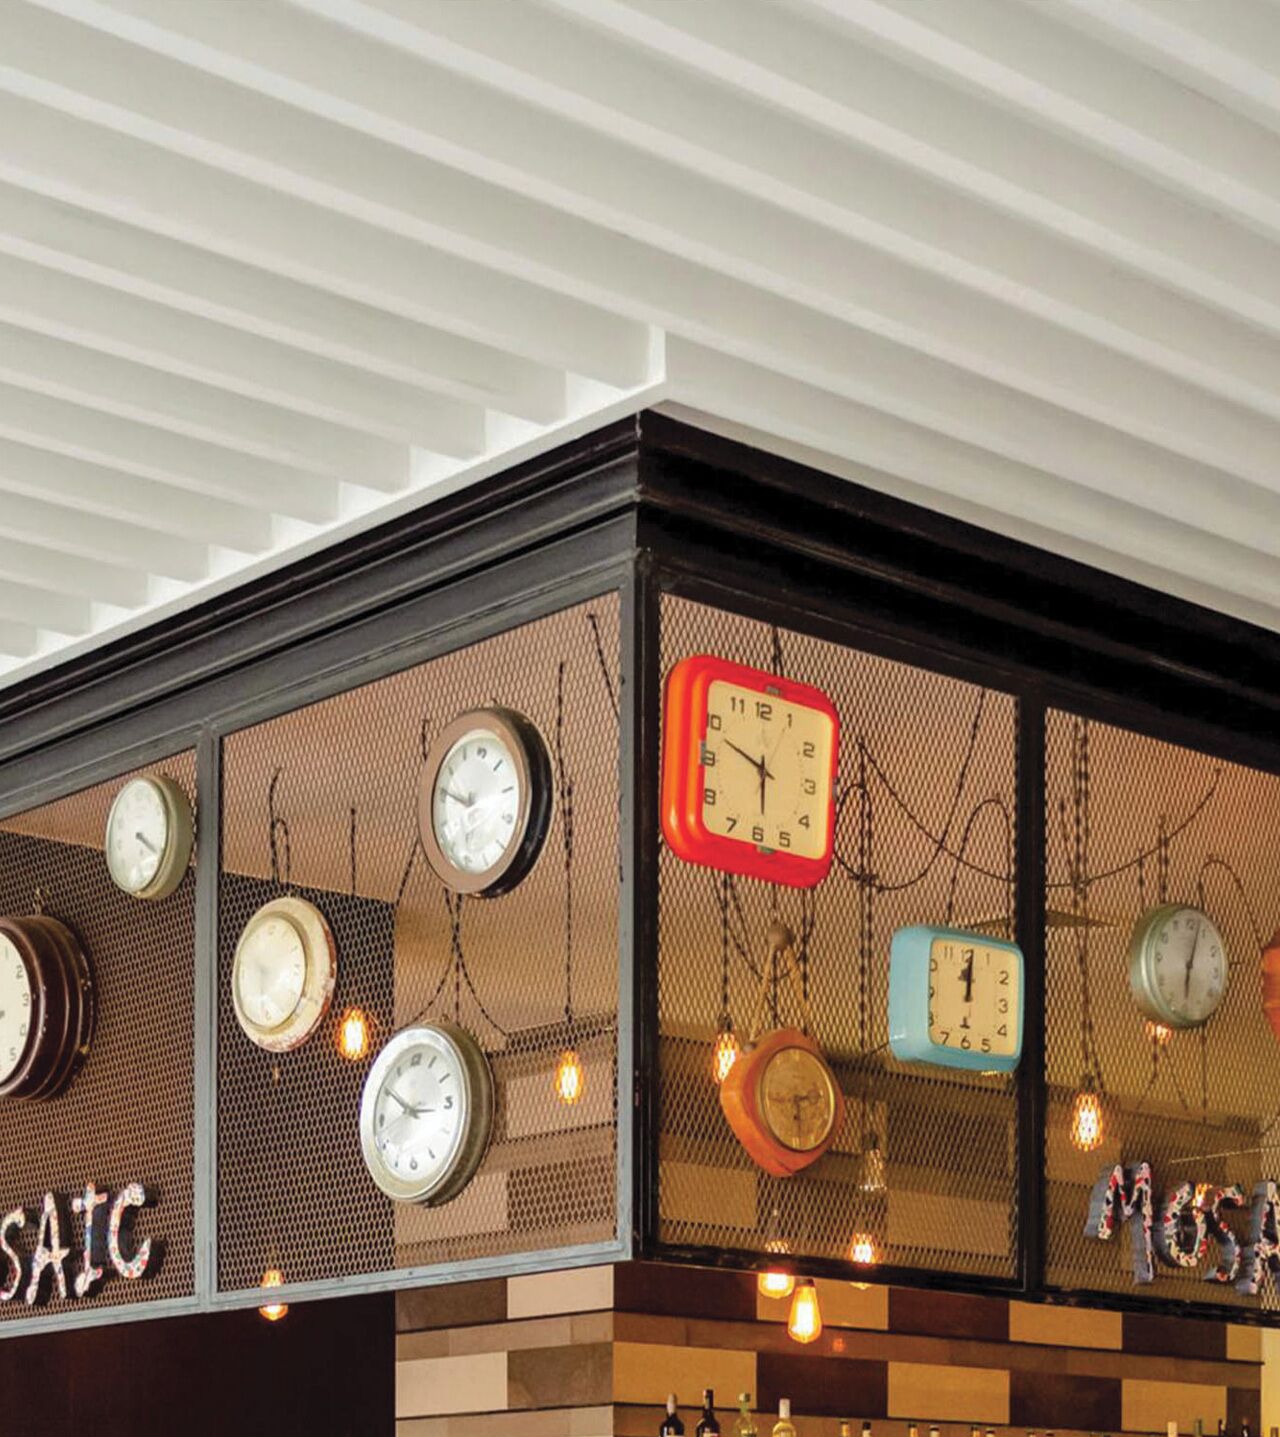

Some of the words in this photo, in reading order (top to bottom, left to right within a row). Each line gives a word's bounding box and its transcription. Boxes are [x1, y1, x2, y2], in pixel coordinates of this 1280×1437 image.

[731, 697, 745, 714] 11
[755, 701, 772, 721] 12
[787, 713, 792, 728] 1
[803, 741, 815, 758] 2
[804, 778, 816, 795] 3
[704, 788, 716, 805] 8
[725, 817, 737, 833] 7
[798, 815, 810, 830] 4
[752, 826, 764, 842] 6
[779, 832, 790, 848] 5
[944, 946, 953, 961] 11
[999, 970, 1009, 985] 2
[998, 999, 1008, 1014] 3
[997, 1024, 1008, 1037] 4
[940, 1031, 950, 1046] 7
[960, 1035, 971, 1050] 6
[980, 1038, 991, 1053] 5
